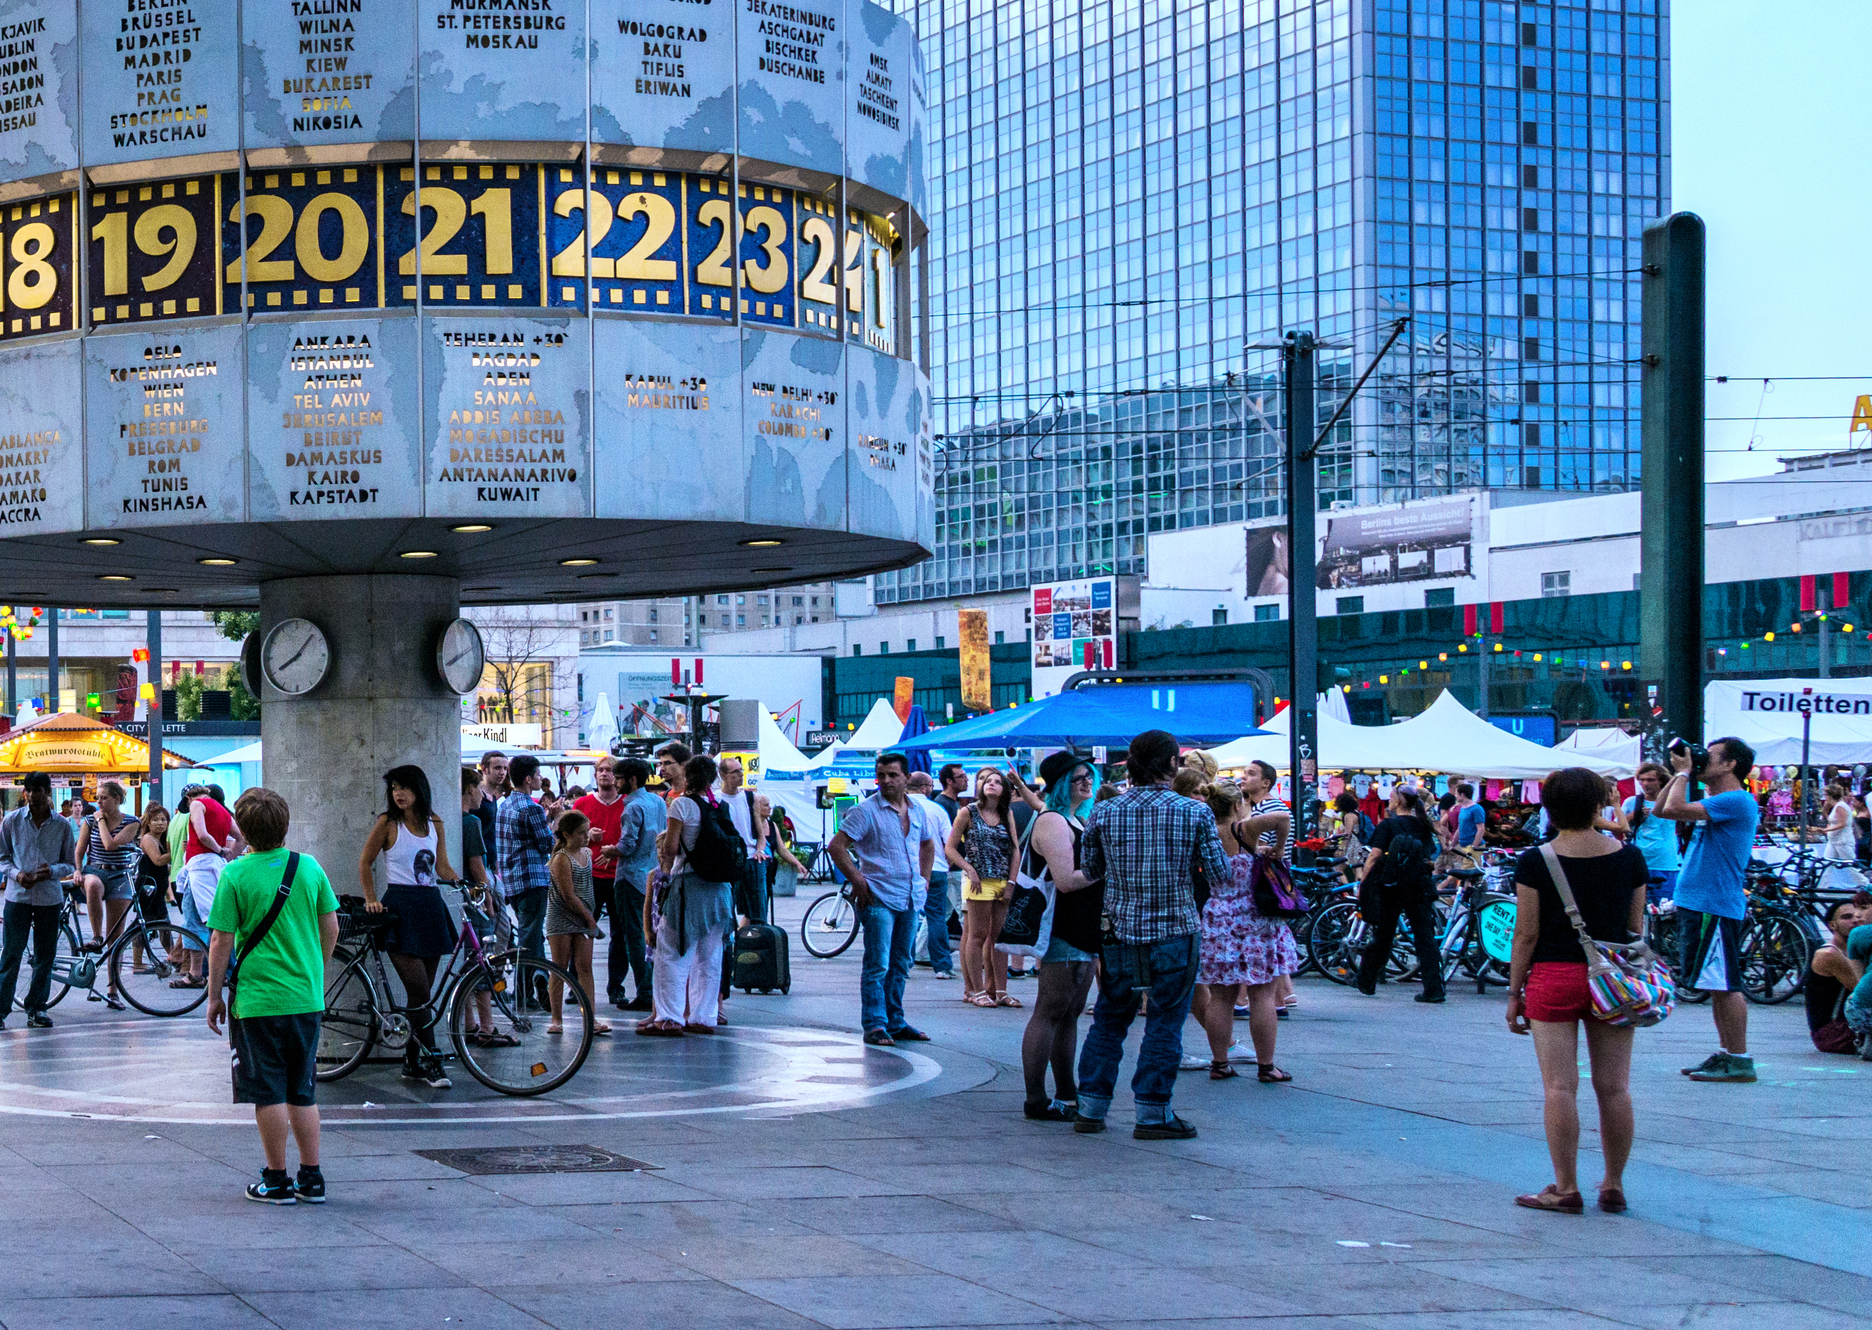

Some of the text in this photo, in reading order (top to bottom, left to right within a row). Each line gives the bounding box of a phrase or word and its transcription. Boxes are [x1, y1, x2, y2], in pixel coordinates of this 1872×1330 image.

[121, 9, 196, 32] BRÜSSEL
[299, 18, 355, 35] WILNA
[437, 15, 566, 30] ST. PETERSBURG
[618, 19, 708, 42] WOLGOGRAD
[758, 20, 825, 48] ASCHGABAT
[116, 27, 202, 52] BUDAPEST
[299, 37, 356, 54] MINSK
[466, 34, 538, 49] MOSKAU
[643, 42, 682, 58] BAKU
[764, 39, 818, 64] BISCHKEK
[124, 48, 192, 70] MADRID
[306, 57, 348, 72] KIEW
[870, 52, 888, 74] OMSK
[641, 61, 684, 78] TIFLIS
[758, 56, 825, 84] DUSCHANBE
[136, 69, 182, 88] PARIS
[283, 75, 373, 94] BUKAREST
[866, 69, 892, 92] ALMATY
[634, 78, 691, 98] ERIWAN
[137, 88, 182, 107] PRAG
[302, 96, 352, 112] SOFIA
[860, 83, 898, 113] TASCHKENT
[110, 104, 208, 130] STOCKHOLM
[293, 114, 363, 132] NIKOSIA
[857, 100, 900, 132] NOWOSIBIRSK
[113, 124, 206, 148] WARSCHAU
[226, 192, 369, 283] 20
[398, 187, 512, 276] 21
[552, 188, 676, 280] 22
[91, 204, 197, 296] 19
[696, 199, 788, 294] 23
[292, 334, 372, 351] ANKARA
[443, 333, 524, 348] TEHERAN
[144, 345, 182, 361] OSLO
[472, 352, 540, 367] BAGDAD
[290, 354, 374, 372] ISTANBUL
[110, 361, 218, 383] KOPENHAGEN
[483, 372, 530, 386] ADEN
[304, 373, 362, 390] ATHEN
[625, 374, 674, 390] KABUL
[143, 383, 184, 398] WIEN
[474, 391, 538, 406] SANAA
[752, 382, 775, 398] NEW
[782, 386, 812, 403] DELHI
[293, 392, 370, 409] TEL AVIV
[628, 394, 709, 410] MAURITIUS
[143, 402, 184, 418] BERN
[448, 410, 566, 425] ADDIS ABEBA
[770, 403, 820, 422] KARACHI
[120, 418, 209, 439] PRESSBURG
[282, 411, 383, 429] JERUSALEM
[449, 428, 564, 444] MOGADISCHU
[758, 420, 807, 438] COLOMBO
[127, 437, 201, 456] BELGRAD
[304, 430, 363, 446] BEIRUT
[286, 450, 382, 467] DAMASKUS
[449, 449, 565, 464] DARESSALAM
[147, 458, 181, 474] ROM
[308, 470, 360, 486] KAIRO
[439, 468, 577, 483] ANTANANARIVO
[141, 477, 189, 494] TUNIS
[290, 488, 378, 505] KAPSTADT
[478, 487, 540, 502] KUWAIT
[122, 495, 208, 514] KINSHASA
[1361, 518, 1391, 529] Berlins
[1394, 514, 1418, 525] beste
[1421, 508, 1464, 522] Aussicht!
[1743, 692, 1870, 714] Toiletten
[126, 724, 145, 732] CITY
[484, 727, 507, 743] Kindl
[1512, 719, 1524, 735] U
[1492, 904, 1510, 920] RENT
